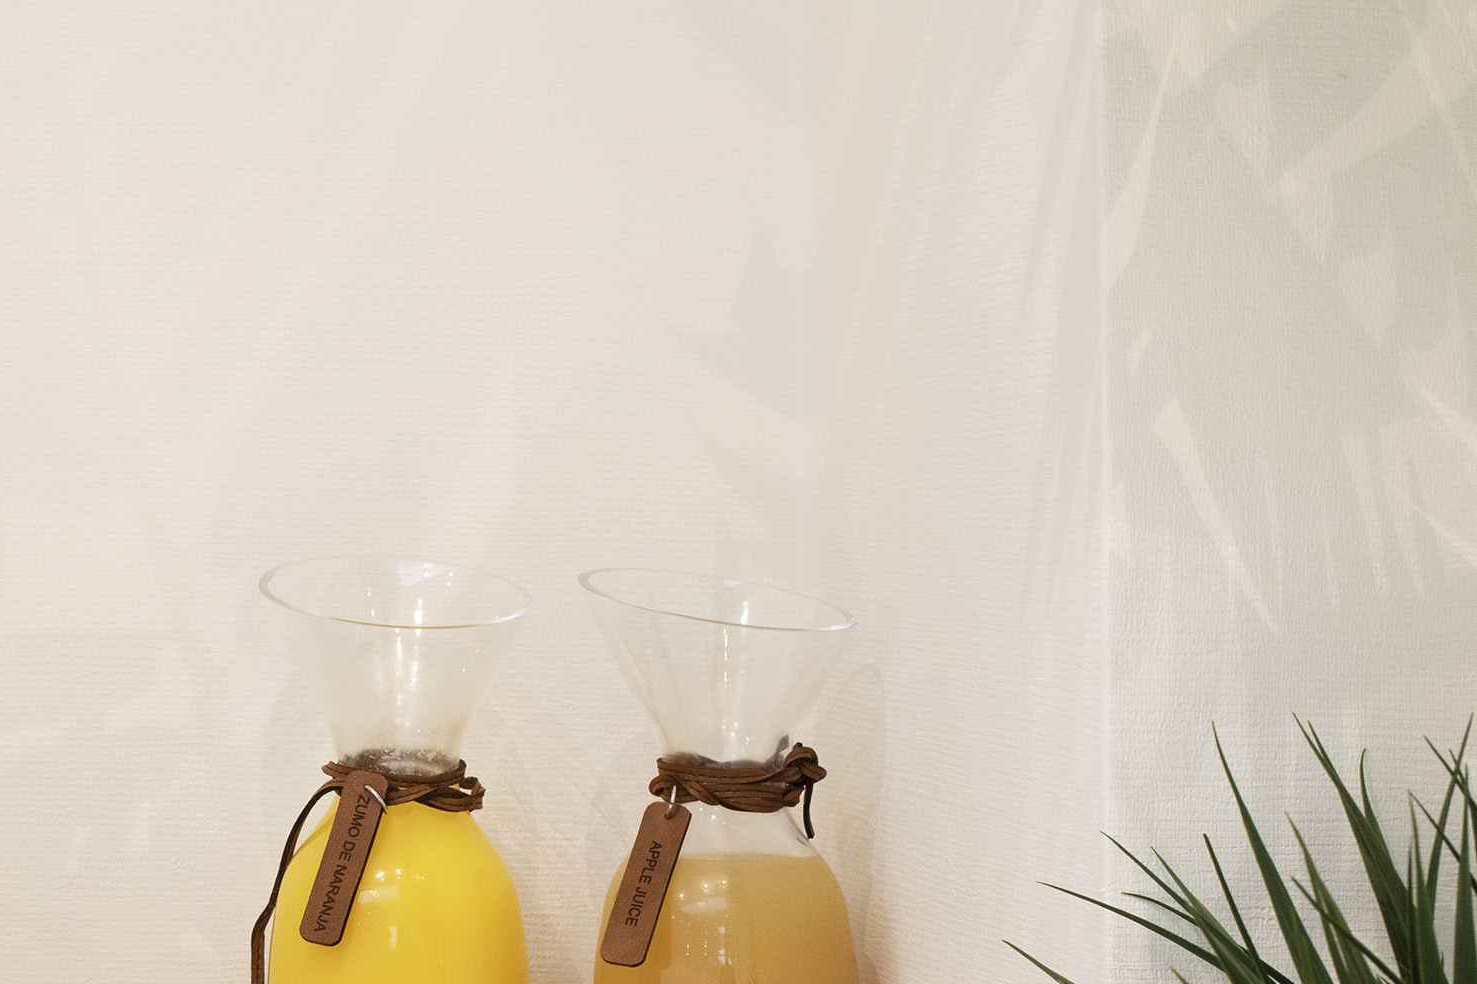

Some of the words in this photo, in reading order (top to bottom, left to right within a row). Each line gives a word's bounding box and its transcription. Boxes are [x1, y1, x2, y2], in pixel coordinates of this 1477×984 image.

[348, 794, 370, 837] ZUMO
[339, 841, 356, 862] DE
[639, 841, 663, 884] APPLE
[314, 865, 347, 932] NARANJA
[625, 887, 647, 927] JUICE
